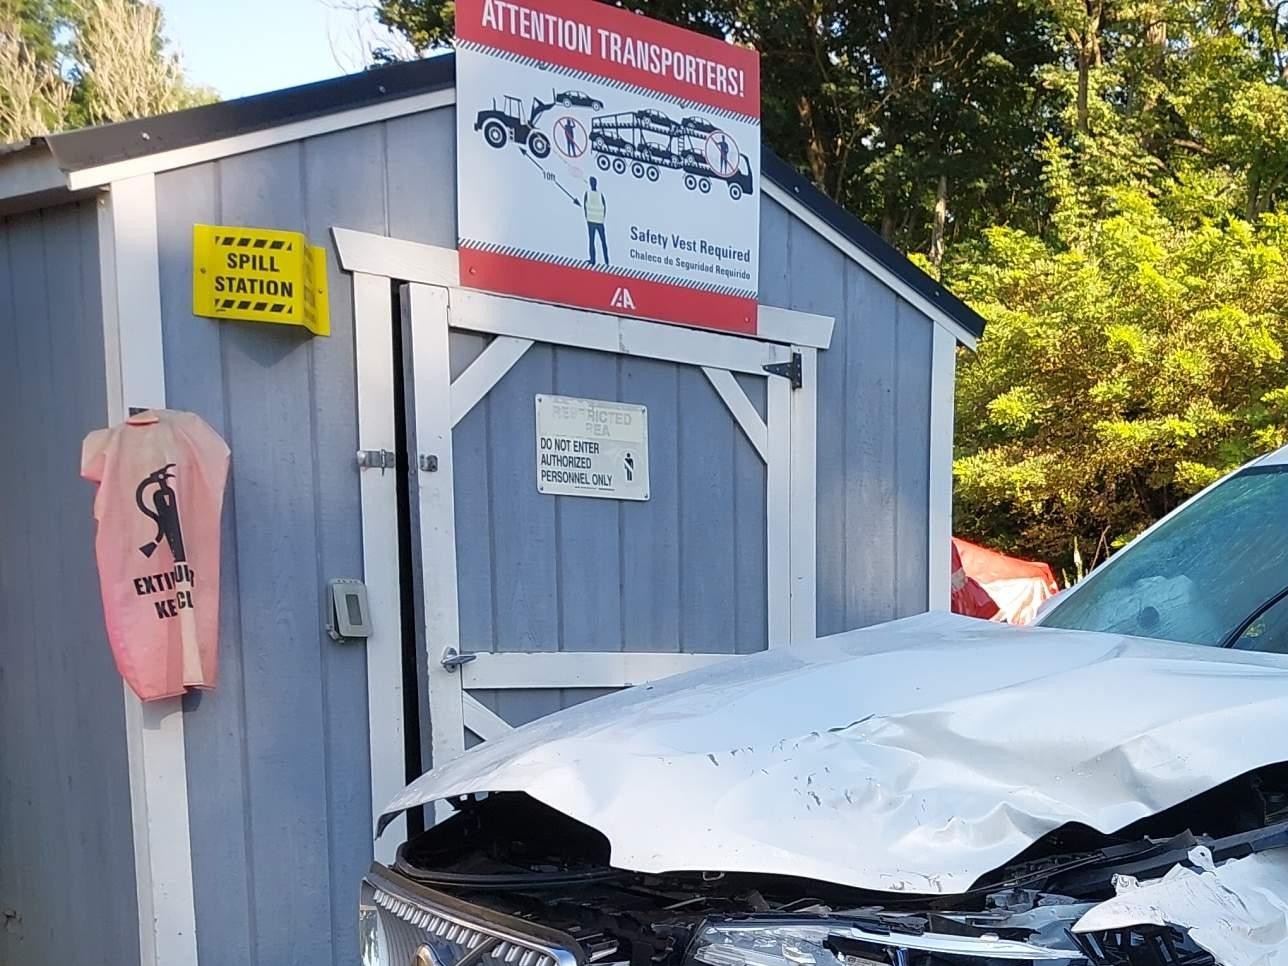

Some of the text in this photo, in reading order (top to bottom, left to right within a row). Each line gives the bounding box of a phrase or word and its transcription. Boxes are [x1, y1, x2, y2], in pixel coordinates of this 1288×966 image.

[482, 0, 744, 97] ATTENTION TRANSPORTERS!
[630, 226, 750, 262] Safety Vest Required
[227, 252, 280, 272] SPILL
[630, 249, 751, 280] Chaleco de Seguridad Requirido
[215, 276, 293, 298] STATION
[540, 437, 600, 454] DO NOT ENTER
[540, 454, 592, 469] AUTHORIZED
[541, 470, 612, 487] PERSONNEL ONLY
